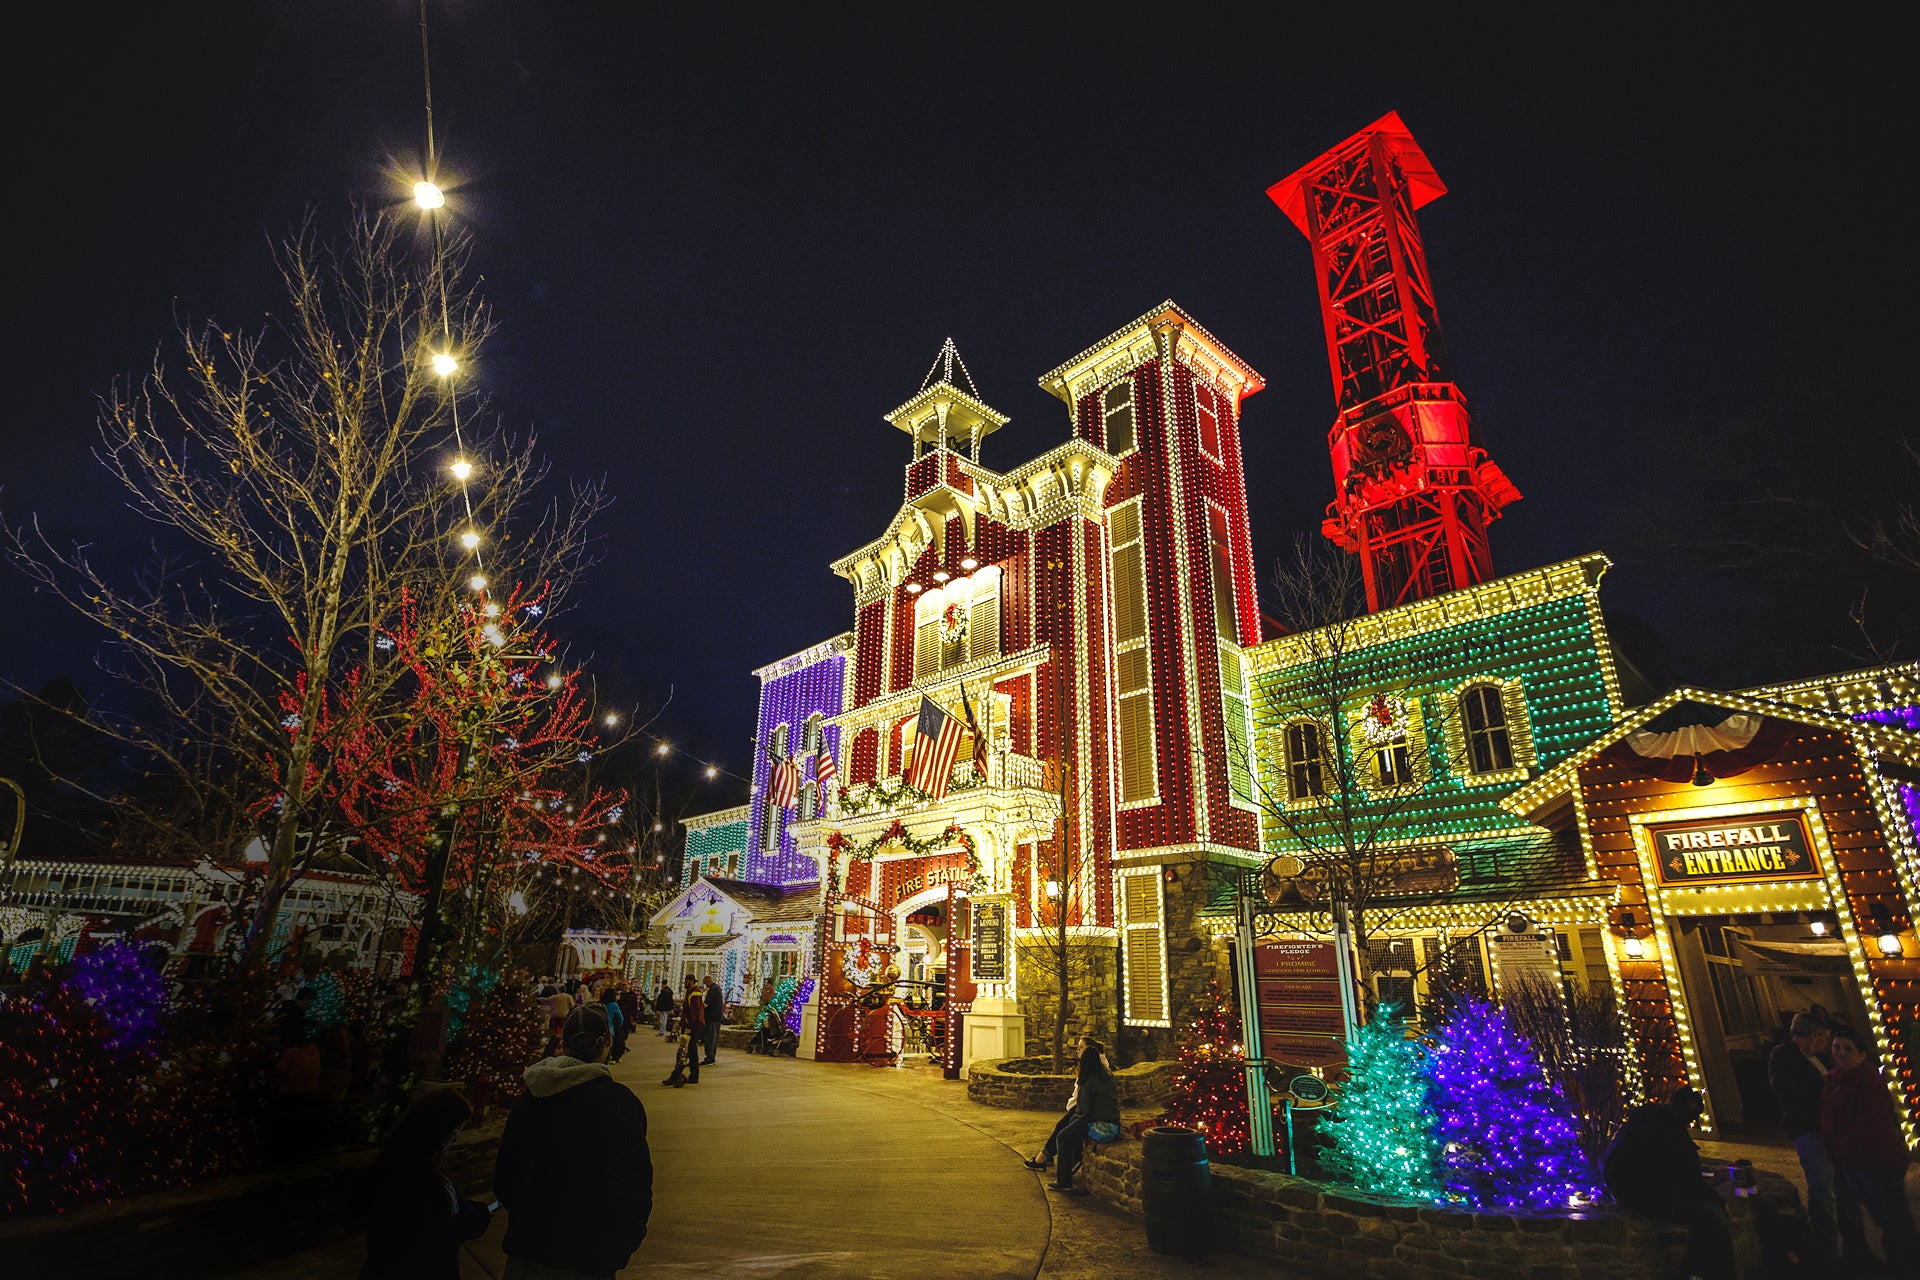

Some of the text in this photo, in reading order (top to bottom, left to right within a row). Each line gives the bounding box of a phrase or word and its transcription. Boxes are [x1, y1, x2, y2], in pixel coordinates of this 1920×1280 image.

[1664, 825, 1790, 850] FIREFALL
[1682, 846, 1786, 875] ENTRANCE
[895, 867, 971, 899] FIRE STATIO
